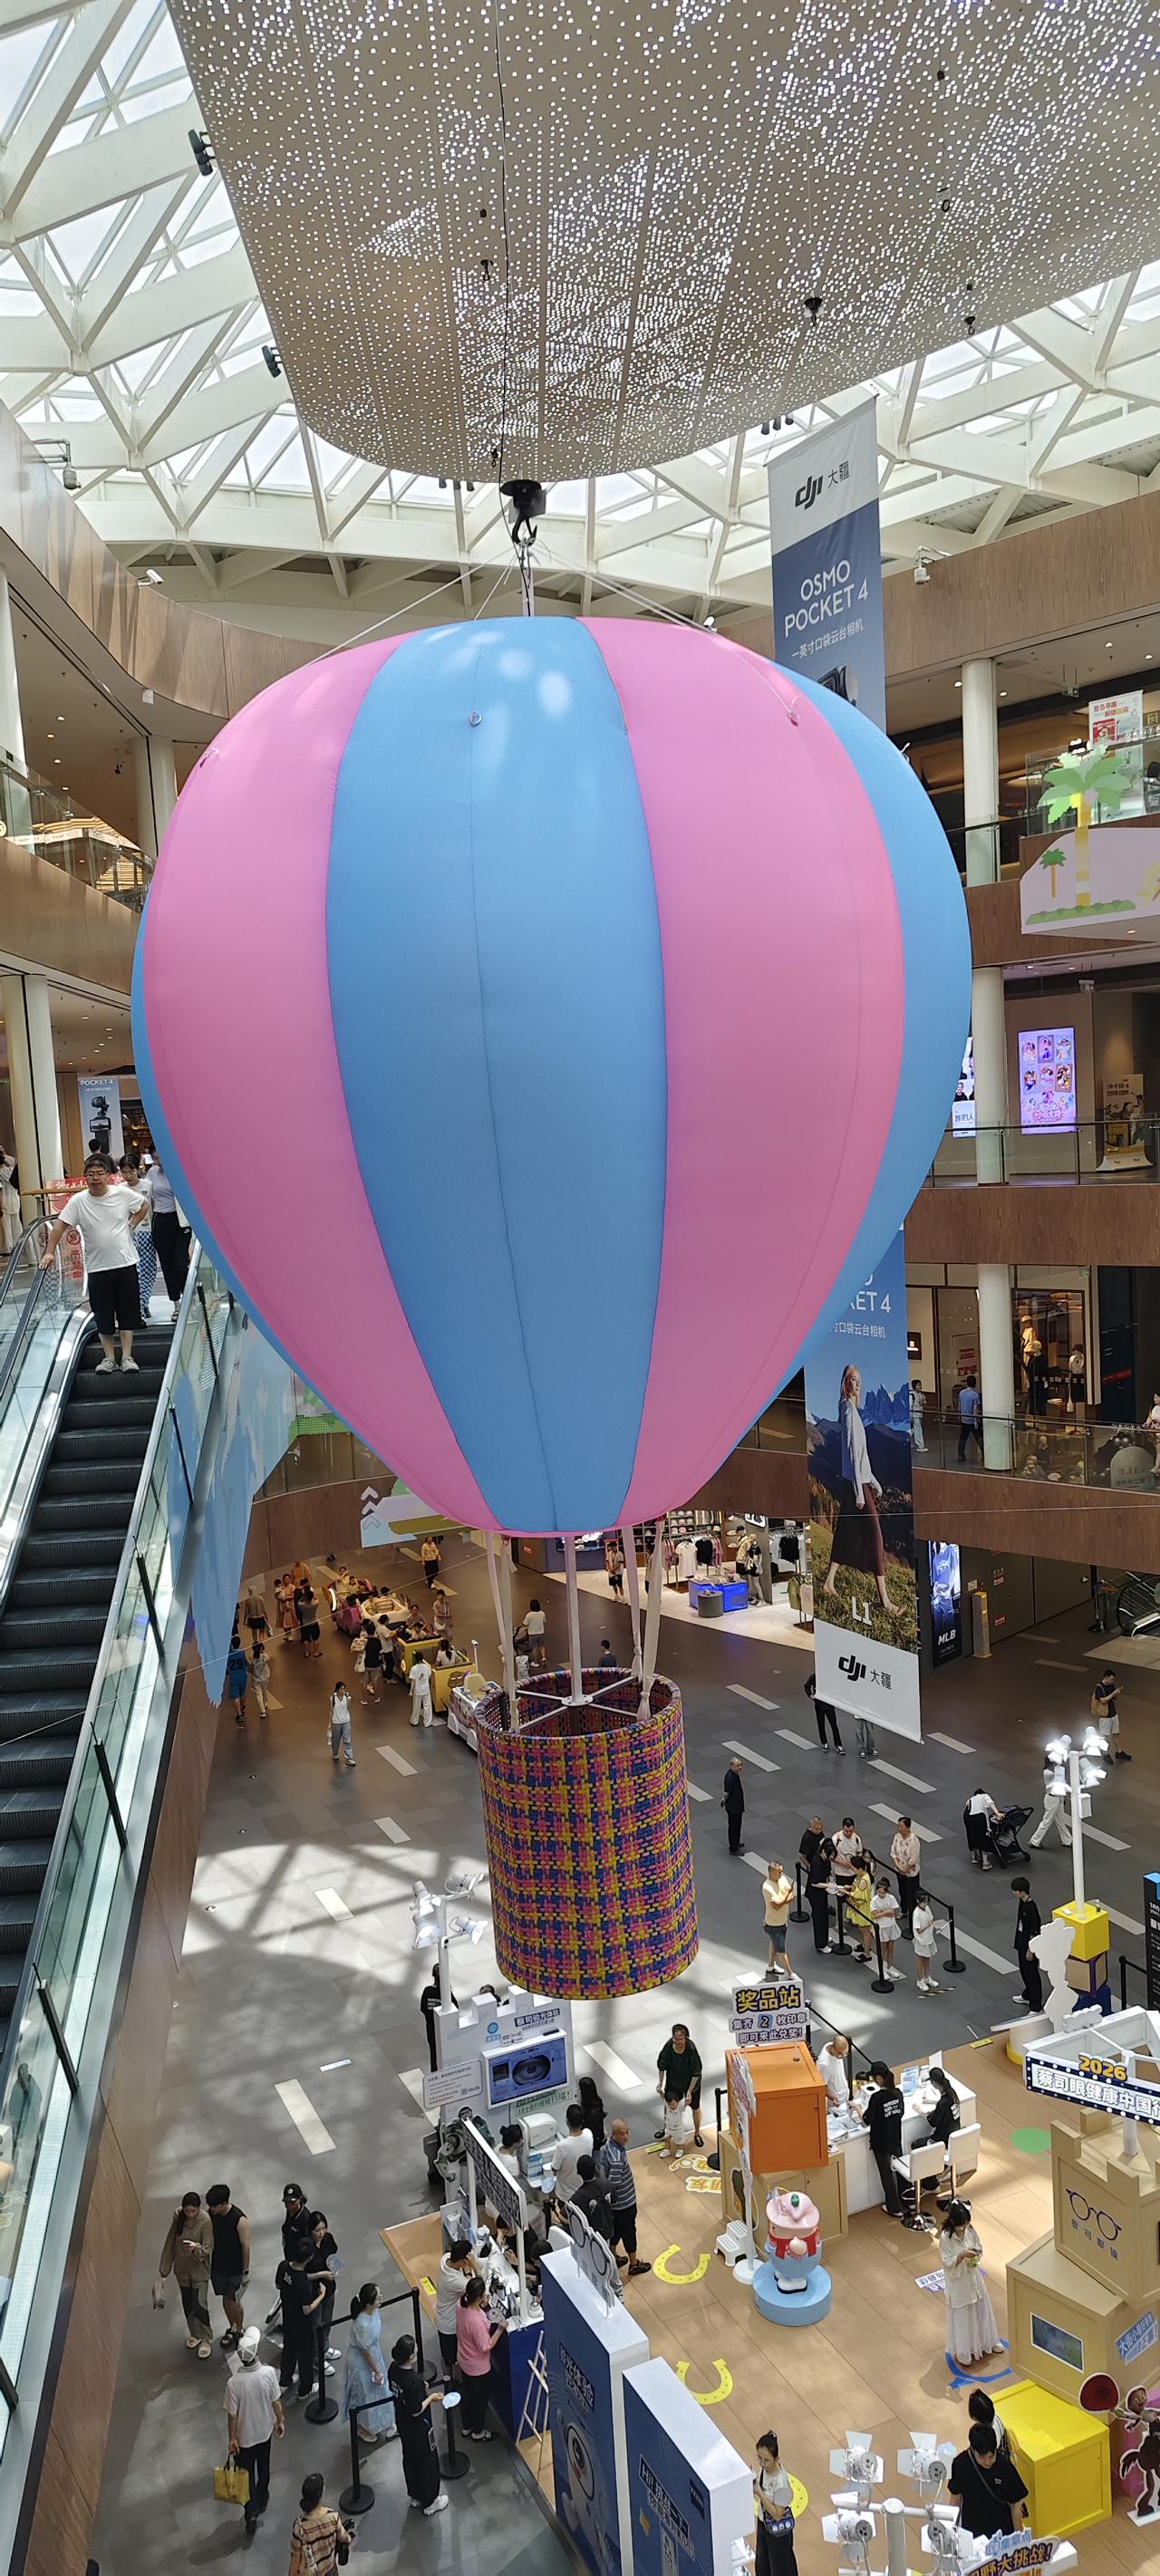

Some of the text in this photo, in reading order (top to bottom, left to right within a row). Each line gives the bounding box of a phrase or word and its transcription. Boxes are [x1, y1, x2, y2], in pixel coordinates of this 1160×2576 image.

[827, 460, 850, 488] 大疆
[800, 560, 850, 601] OSMO
[785, 577, 868, 638] POCKET 4
[791, 618, 863, 659] 一英寸口袋云台相机
[880, 1293, 891, 1314] 4
[938, 1630, 956, 1645] MLB
[870, 1669, 892, 1690] 大疆
[736, 1984, 800, 2013] 奖品站
[732, 2012, 807, 2030] 集齐 2 枚印章
[739, 2027, 803, 2044] 即可来此兑奖!
[1078, 2053, 1127, 2082] 2026
[966, 2542, 1052, 2576] 野大挑战!
